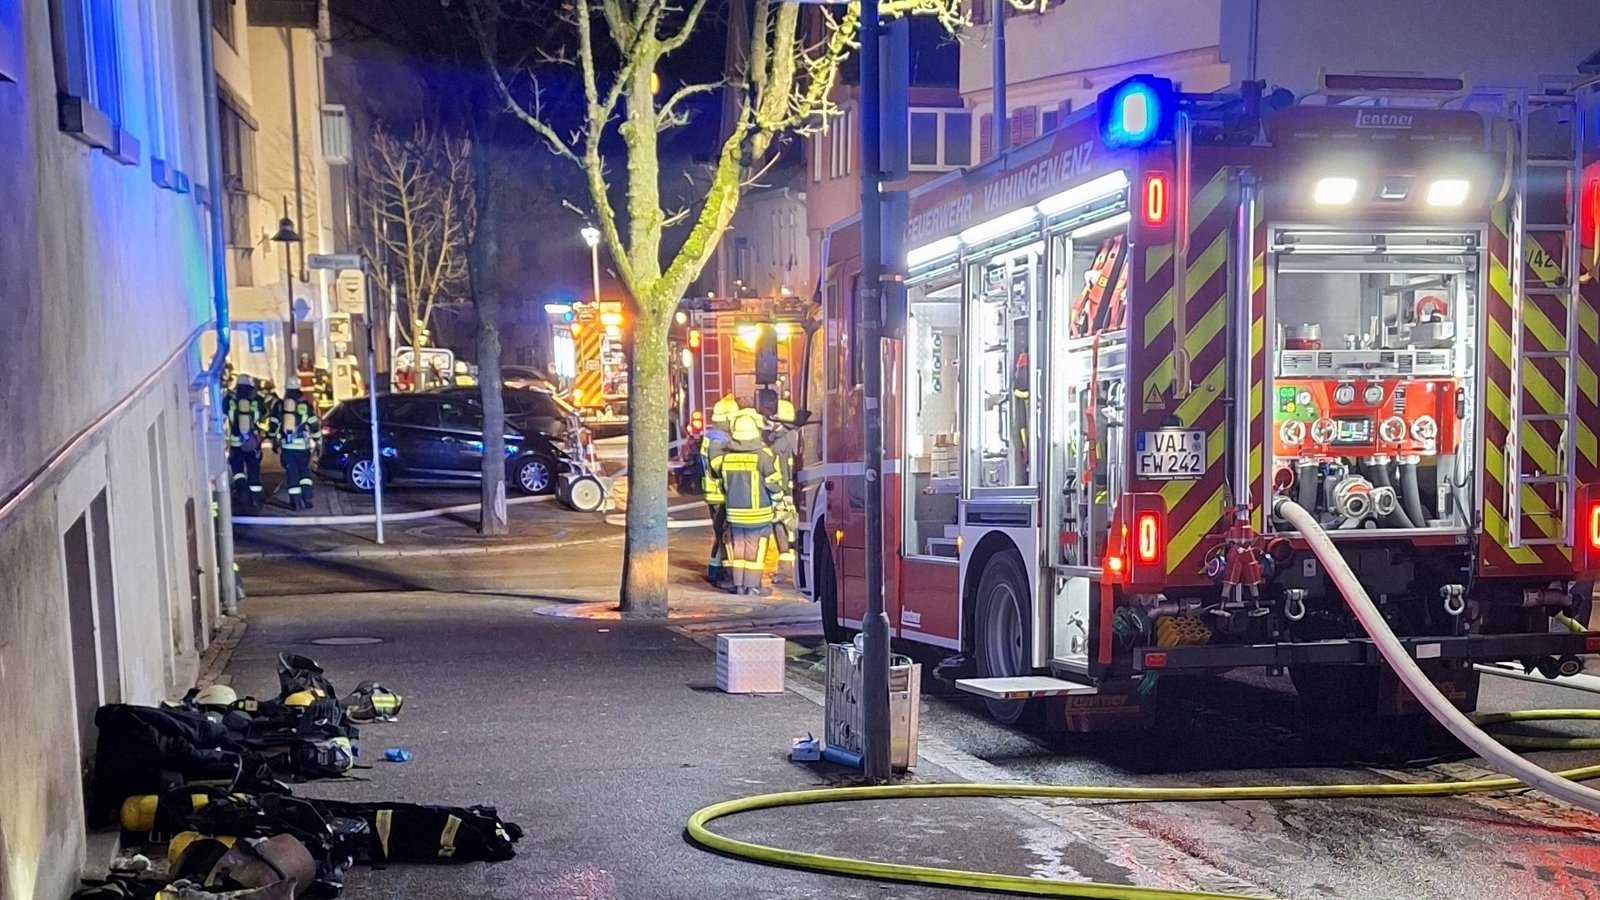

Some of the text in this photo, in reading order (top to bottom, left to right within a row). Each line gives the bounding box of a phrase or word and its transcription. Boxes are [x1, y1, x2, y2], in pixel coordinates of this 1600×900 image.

[907, 140, 1094, 241] FEUERWEHR VAIHINGEN/ENZ
[1525, 249, 1553, 268] /42
[251, 328, 261, 345] P
[1154, 434, 1187, 453] VAI
[1141, 454, 1200, 473] FW 242
